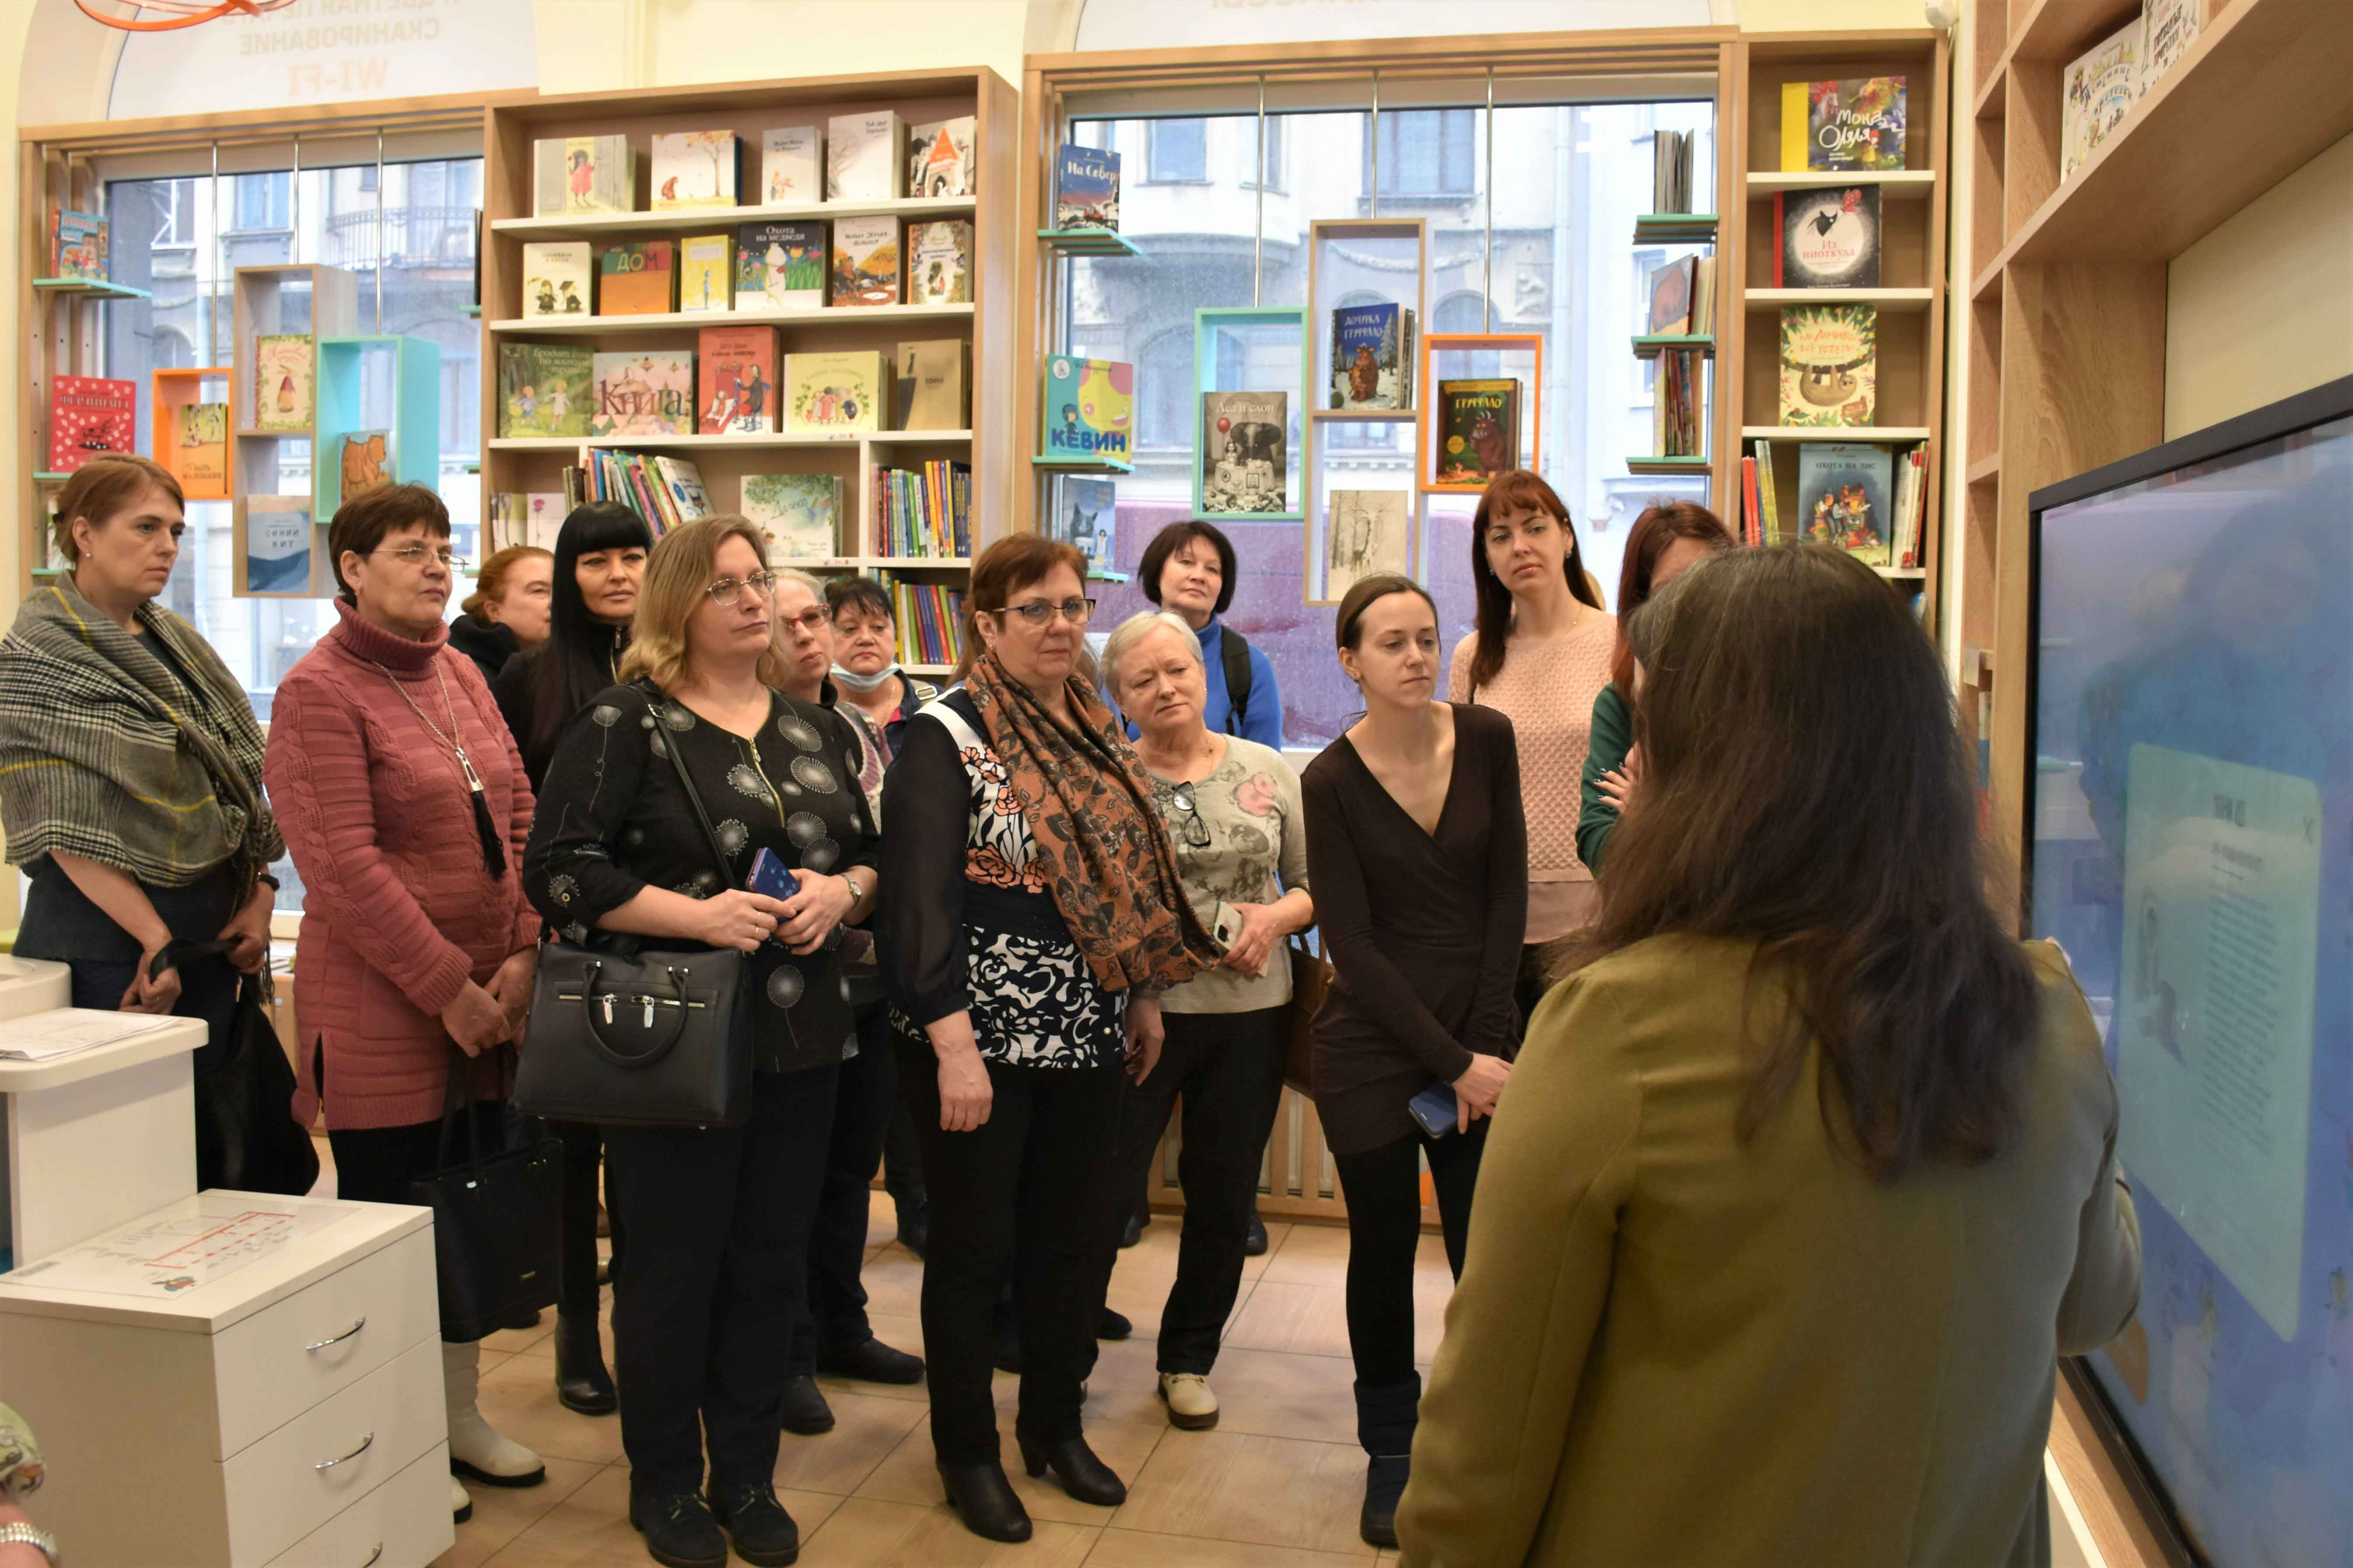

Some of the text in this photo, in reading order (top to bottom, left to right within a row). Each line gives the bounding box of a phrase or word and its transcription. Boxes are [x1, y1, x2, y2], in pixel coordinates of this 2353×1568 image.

[1836, 109, 1882, 126] Мона
[1067, 161, 1083, 176] На
[766, 226, 795, 235] Охота
[769, 233, 805, 242] медведя
[617, 252, 658, 273] ДОМ
[599, 378, 683, 416] Книга
[1051, 427, 1126, 453] КЕВИН
